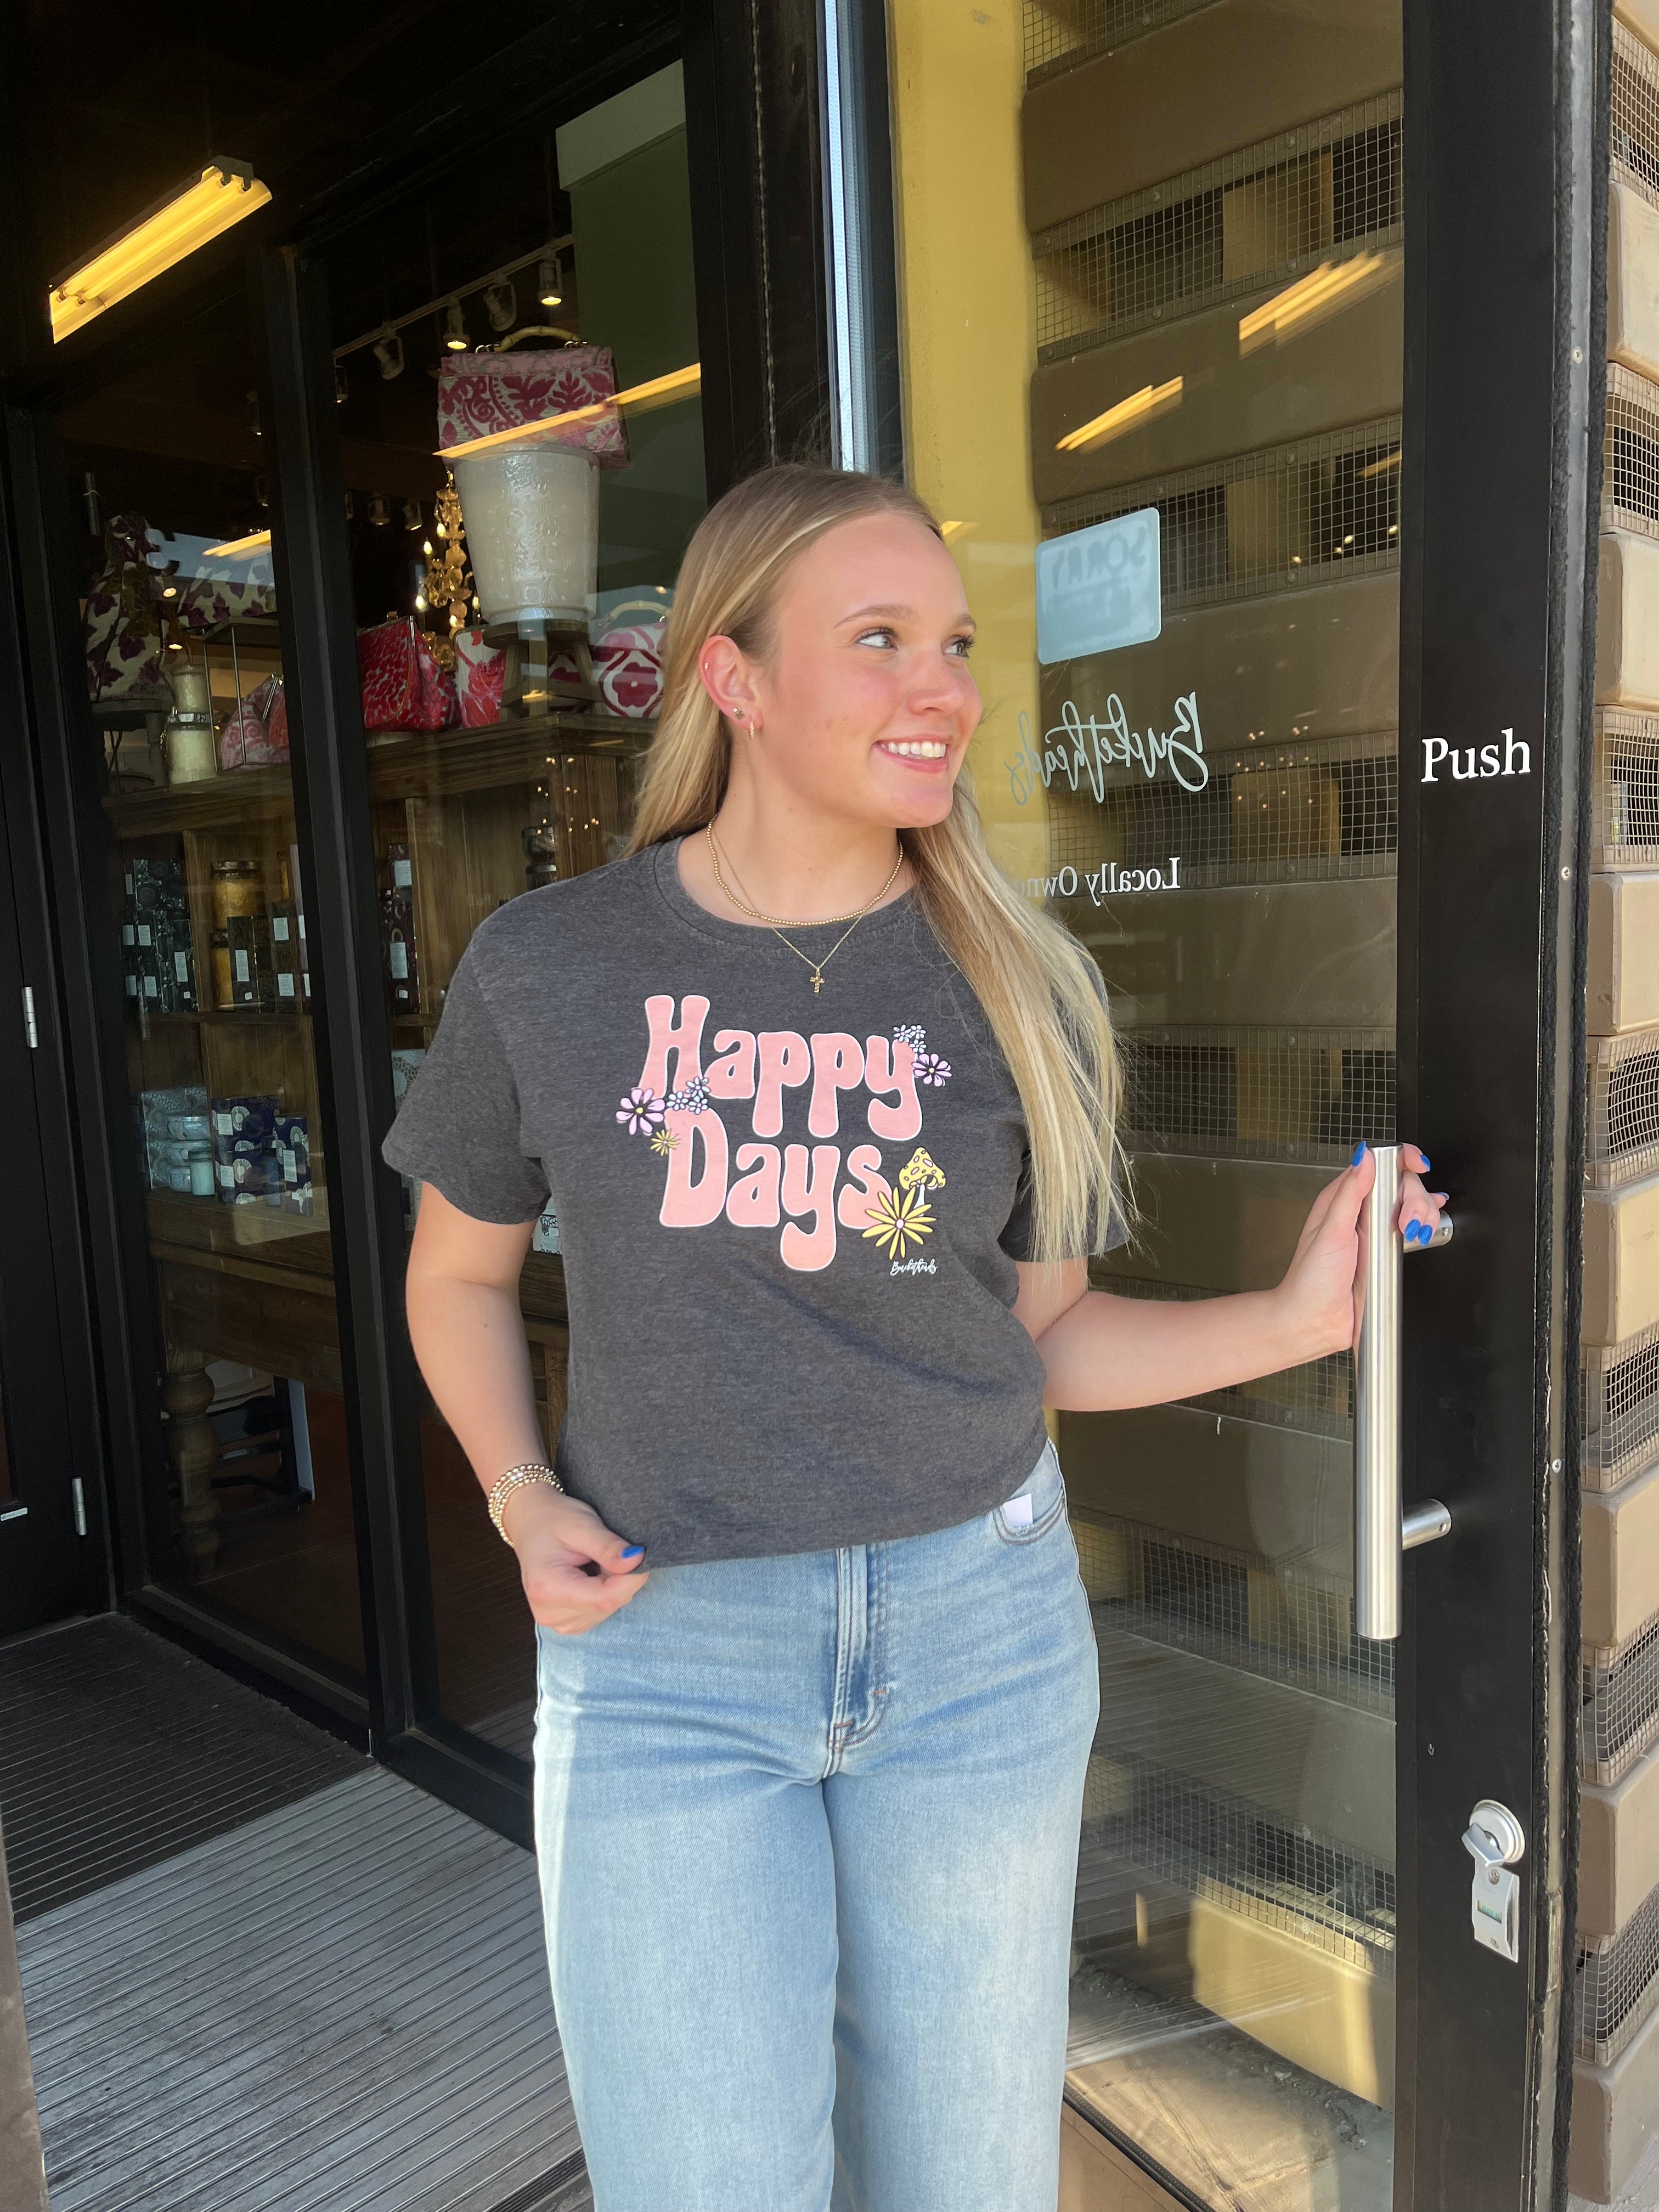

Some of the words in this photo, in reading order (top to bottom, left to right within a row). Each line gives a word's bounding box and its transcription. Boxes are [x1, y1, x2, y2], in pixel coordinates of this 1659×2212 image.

[1421, 727, 1531, 783] Push
[637, 995, 923, 1141] Happy
[659, 1107, 894, 1272] Days
